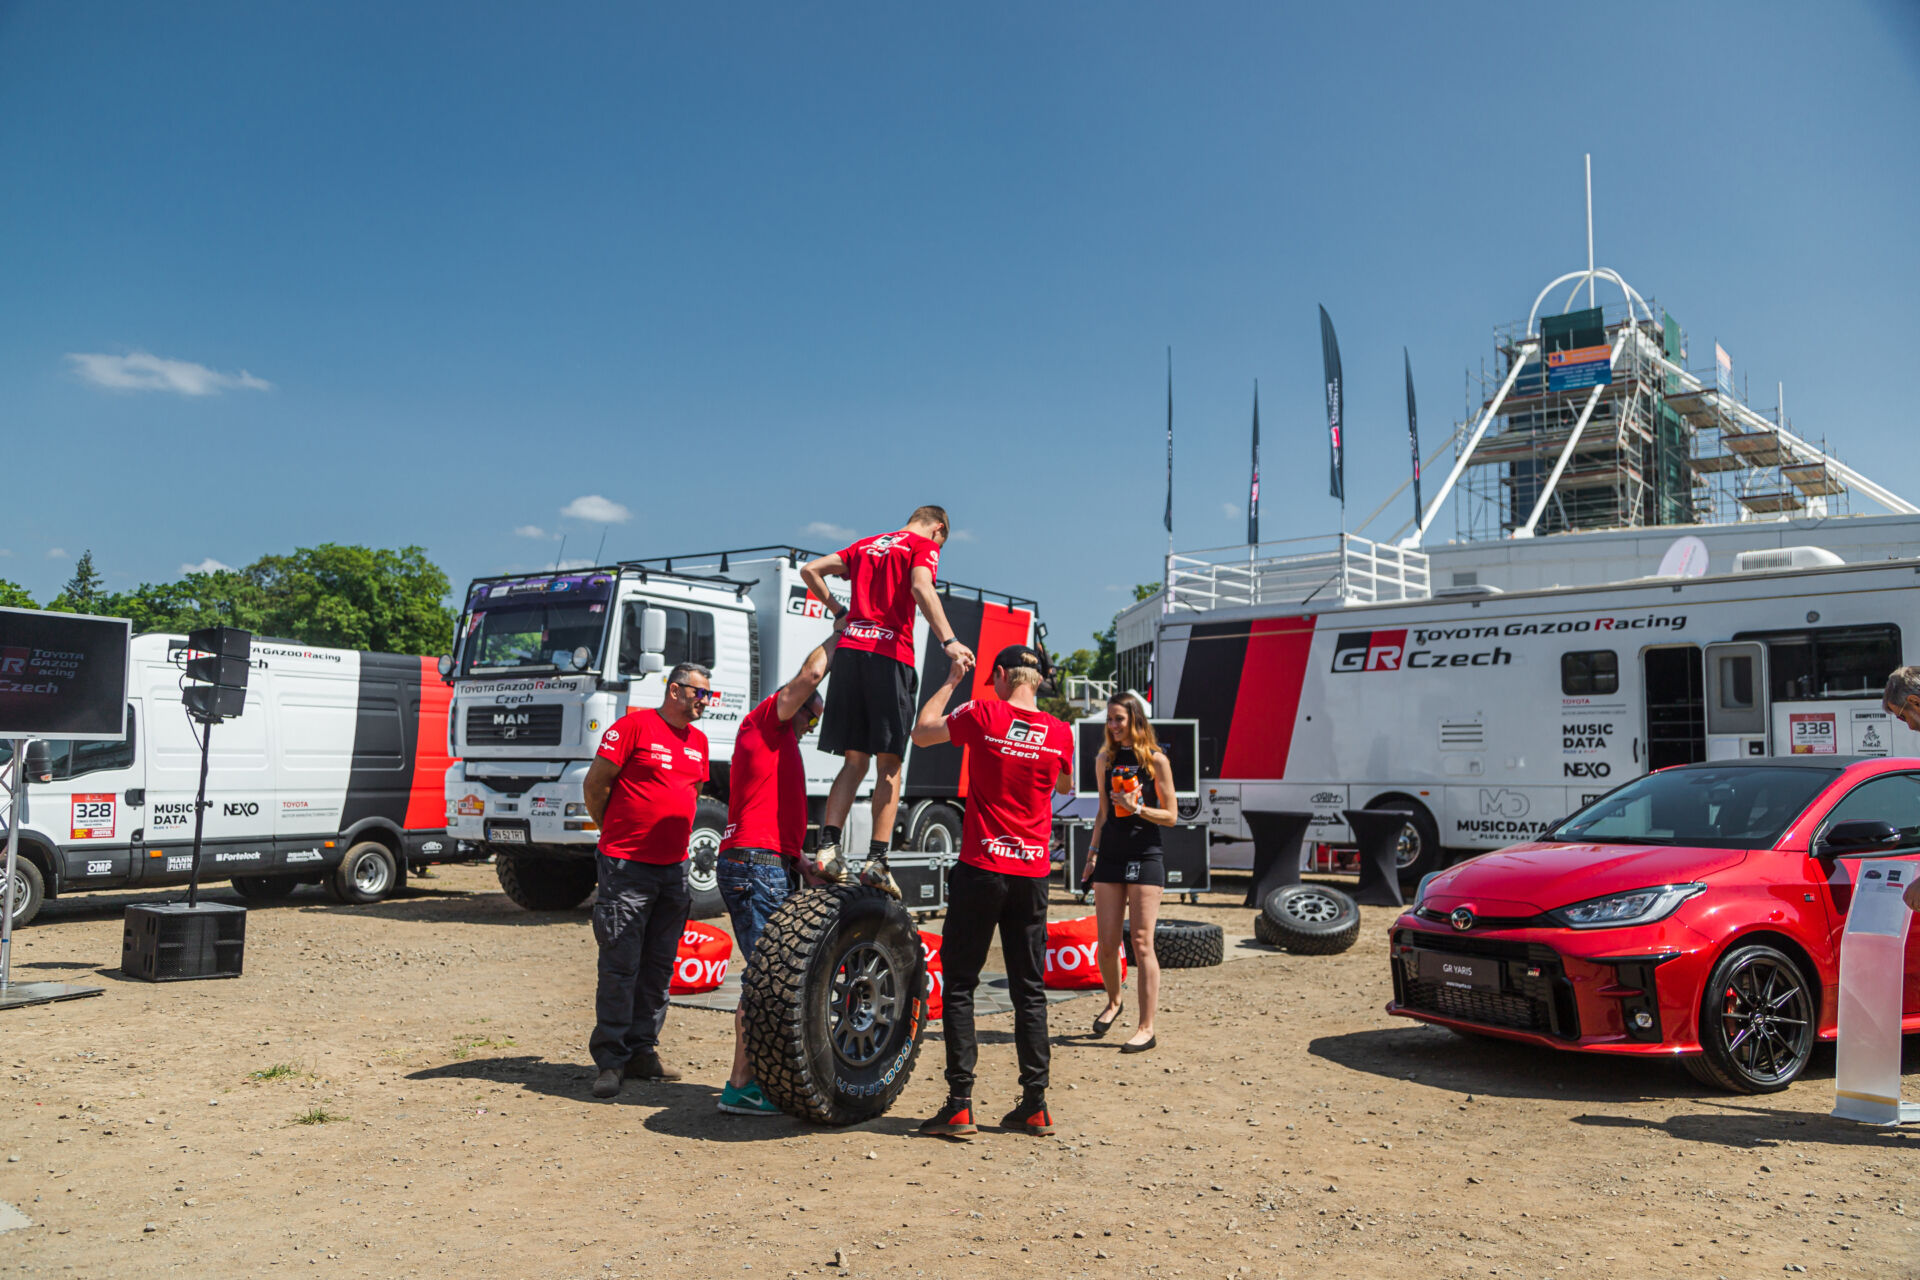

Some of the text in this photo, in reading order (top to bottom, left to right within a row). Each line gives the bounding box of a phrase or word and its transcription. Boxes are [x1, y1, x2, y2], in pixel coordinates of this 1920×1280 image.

[787, 596, 823, 619] GR
[844, 626, 883, 640] HILUX
[1414, 615, 1687, 641] TOYOTA GAZOO Racing
[33, 649, 85, 660] TOYOTA
[262, 648, 341, 663] GAZOO Racing
[1333, 645, 1402, 672] GR
[1407, 647, 1512, 668] Czech
[30, 658, 79, 669] GAZOO
[460, 681, 578, 694] TOYOTA GAZOO Racing
[495, 693, 534, 704] Czech
[493, 713, 529, 725] MAN
[702, 710, 738, 721] Czech
[1562, 724, 1613, 735] MUSIC
[1796, 722, 1831, 735] 338
[1008, 727, 1045, 745] GR
[1563, 737, 1607, 748] DATA
[984, 735, 1062, 755] TOYOTA GAZOO Racing
[1000, 746, 1040, 760] Czech
[1564, 762, 1611, 779] NEXO
[76, 803, 112, 818] 328
[154, 803, 194, 813] MUSIC
[223, 802, 259, 817] NEXO
[154, 815, 187, 824] DATA
[1457, 820, 1548, 833] MUSICDATA
[222, 851, 261, 861] Fortelock
[987, 843, 1036, 860] HILUX
[87, 863, 112, 872] OMP
[1045, 941, 1099, 972] TOY
[1443, 964, 1473, 976] GR YARIS
